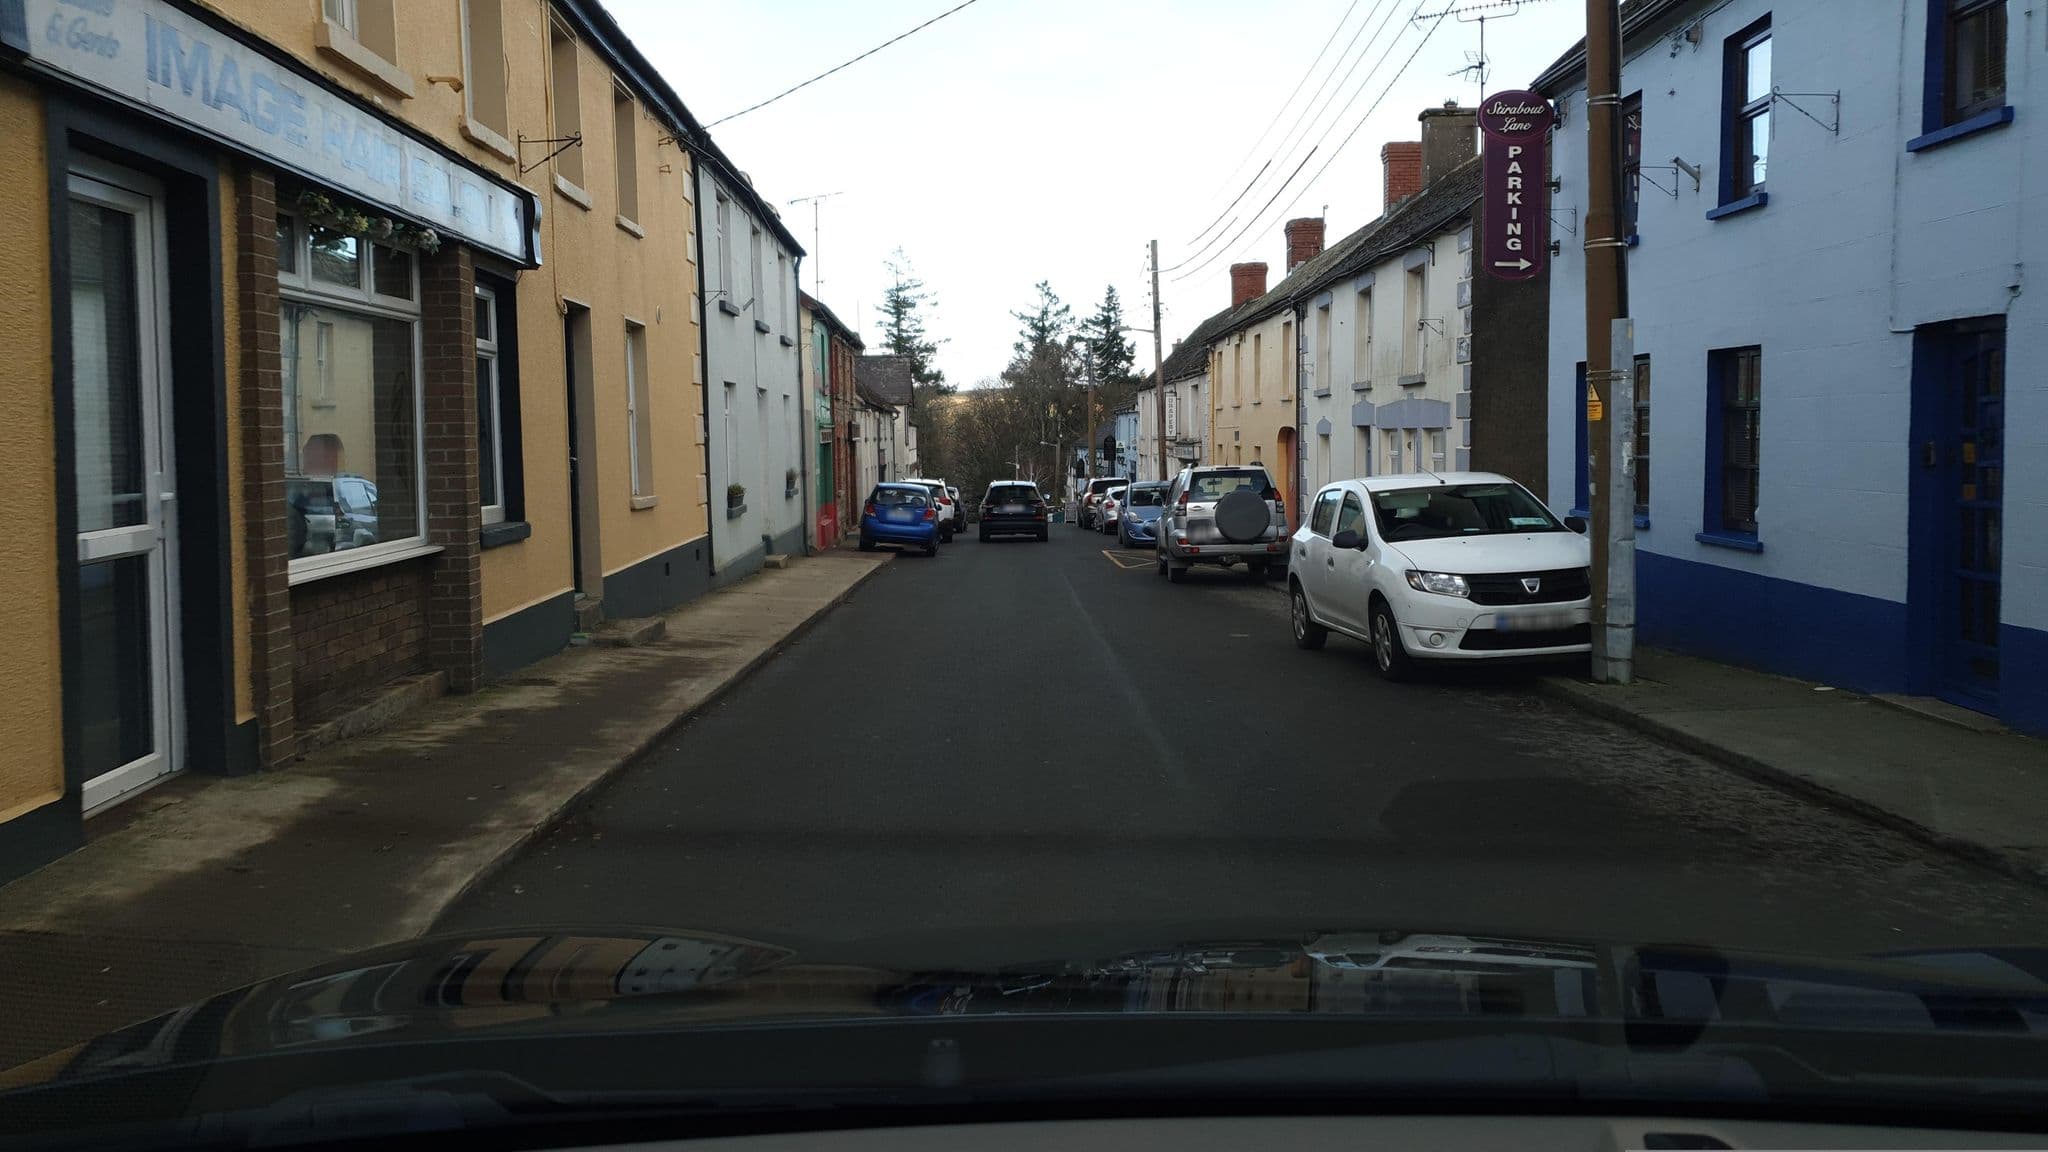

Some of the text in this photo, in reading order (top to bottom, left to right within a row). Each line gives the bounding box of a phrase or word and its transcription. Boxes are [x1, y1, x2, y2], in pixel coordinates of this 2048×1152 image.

[146, 13, 306, 148] IMAGE
[1486, 101, 1545, 115] Stirabout
[1499, 117, 1532, 133] Lane
[1506, 145, 1523, 251] PARKING
